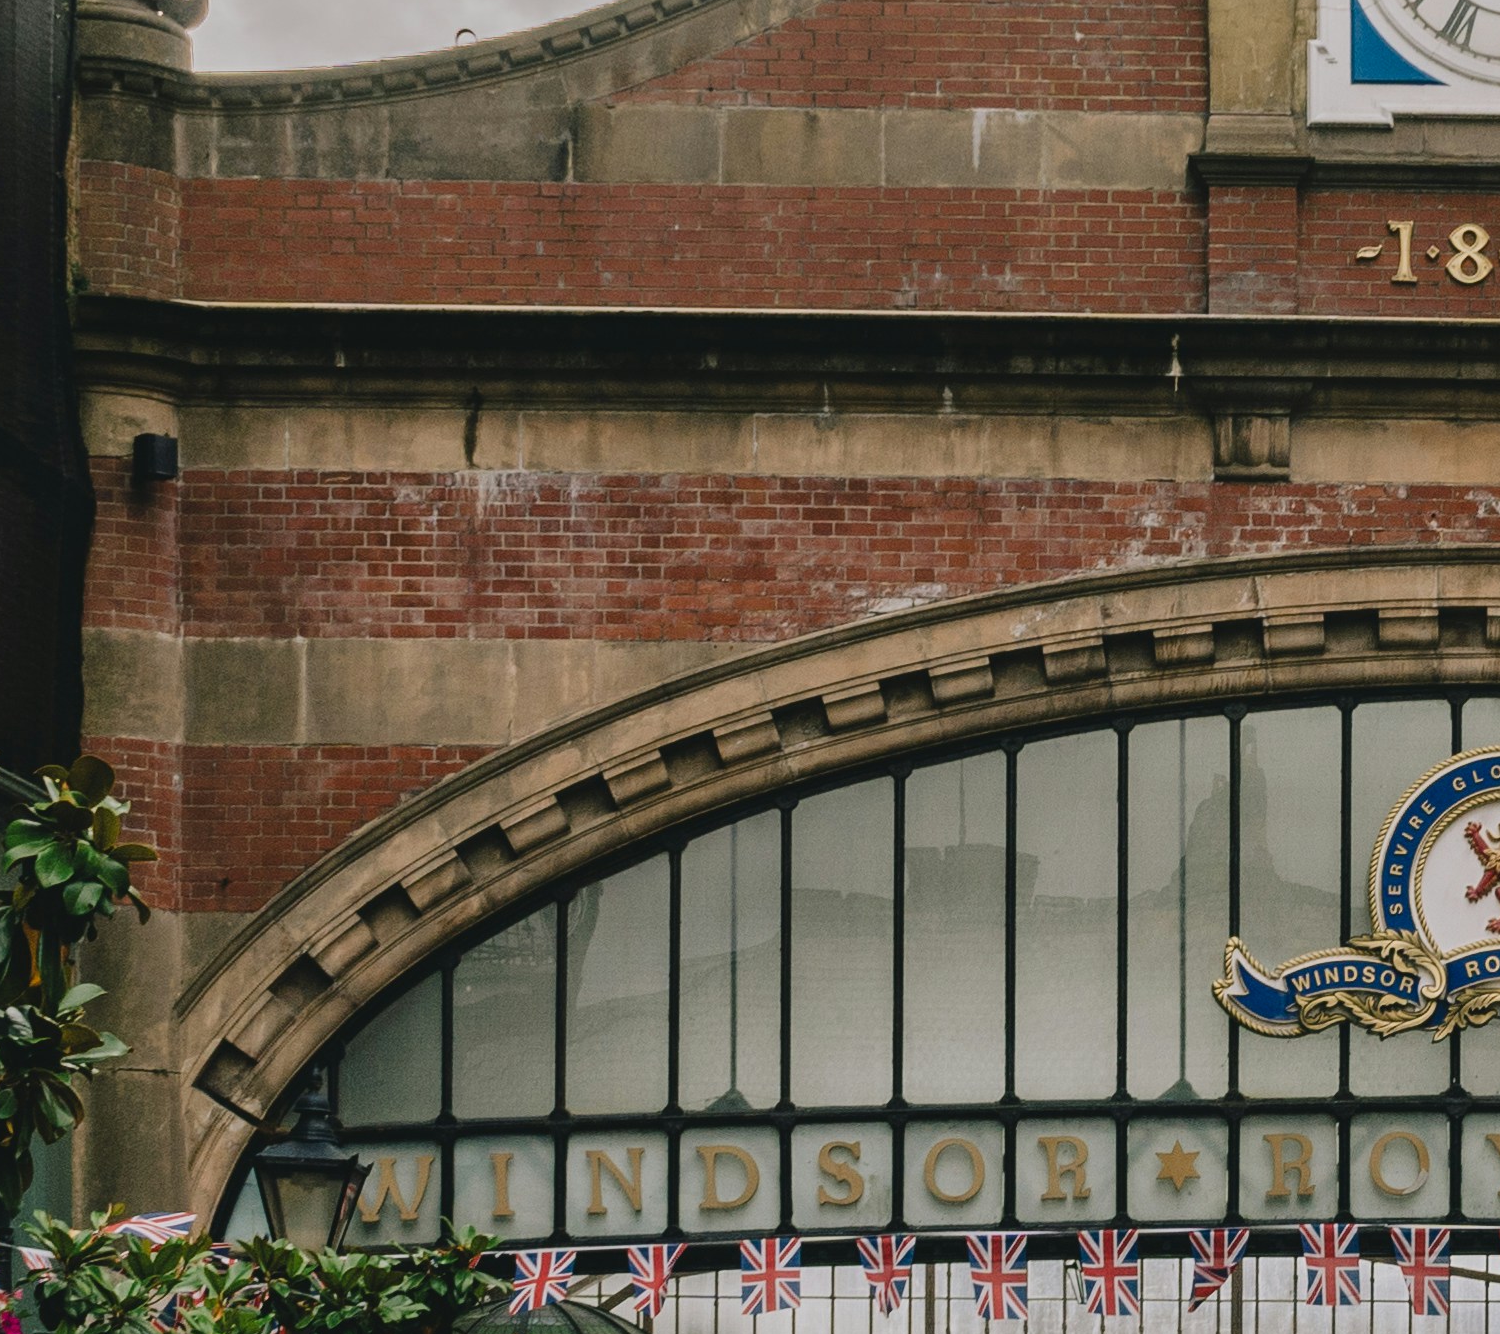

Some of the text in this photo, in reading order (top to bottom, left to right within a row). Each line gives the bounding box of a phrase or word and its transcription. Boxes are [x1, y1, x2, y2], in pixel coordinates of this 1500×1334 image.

[1390, 800, 1436, 915] SERVIRE
[1291, 964, 1416, 995] WINDSOR
[357, 1137, 1091, 1223] WINDSOR
